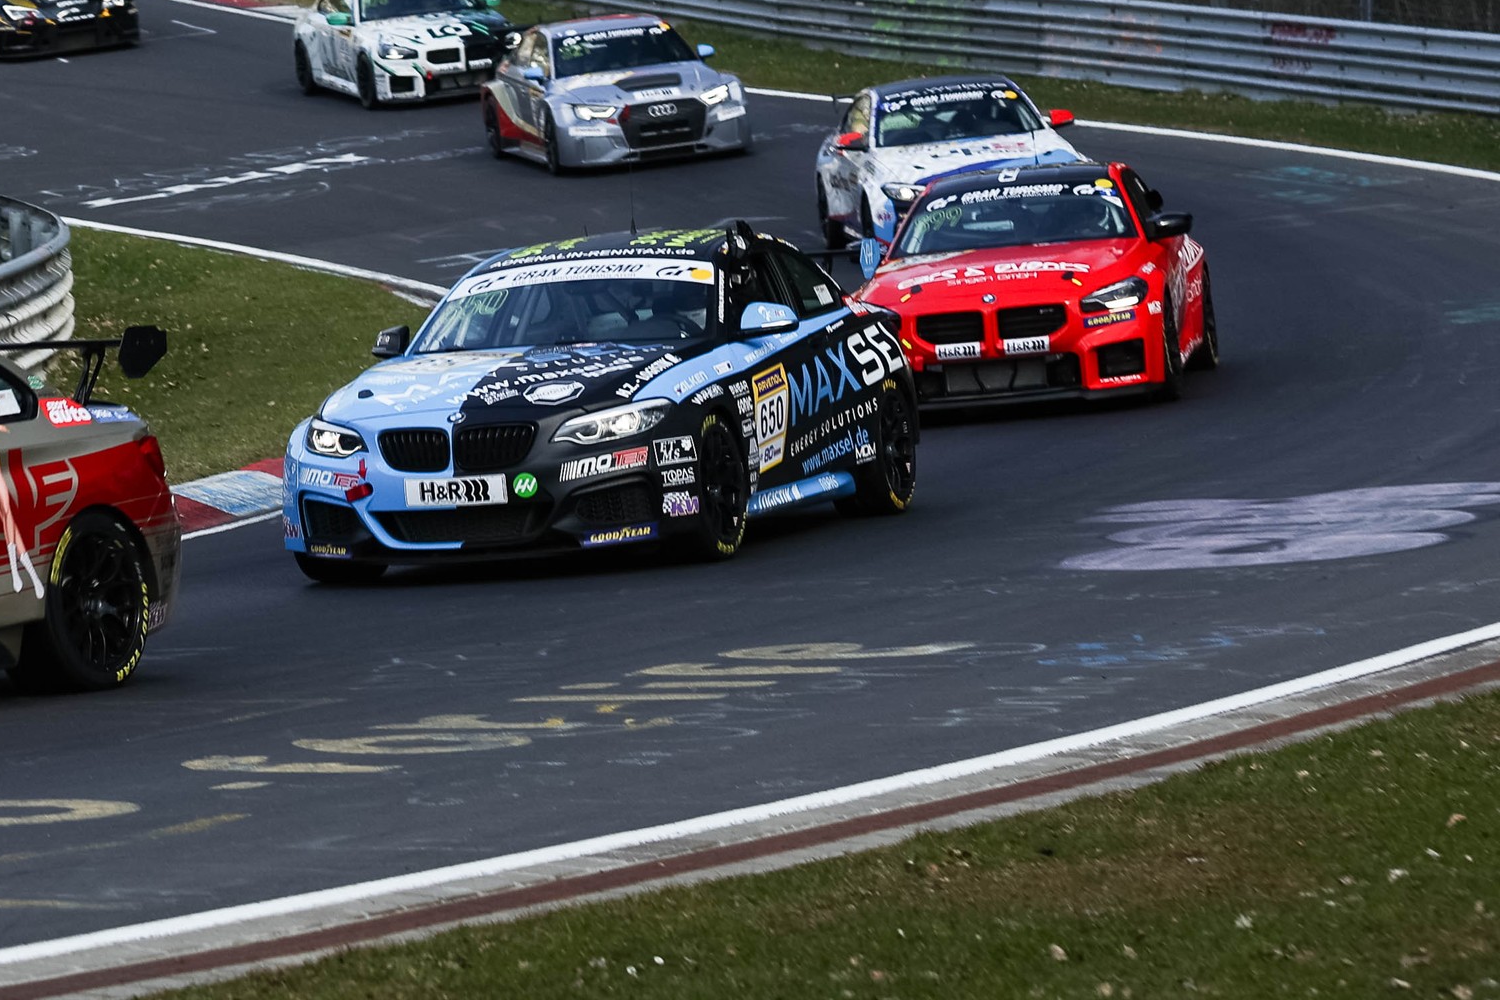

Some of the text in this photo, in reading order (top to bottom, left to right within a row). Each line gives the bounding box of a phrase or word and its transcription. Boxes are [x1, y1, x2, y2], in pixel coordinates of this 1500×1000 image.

[512, 267, 563, 282] GRAN
[48, 405, 92, 425] auto
[760, 396, 784, 440] 650
[790, 397, 879, 458] ENERGY SOLUTIONS
[801, 425, 870, 476] www.maxsel.de
[660, 466, 695, 482] TOPAS
[670, 495, 700, 517] KW
[590, 526, 651, 543] GOODYEAR
